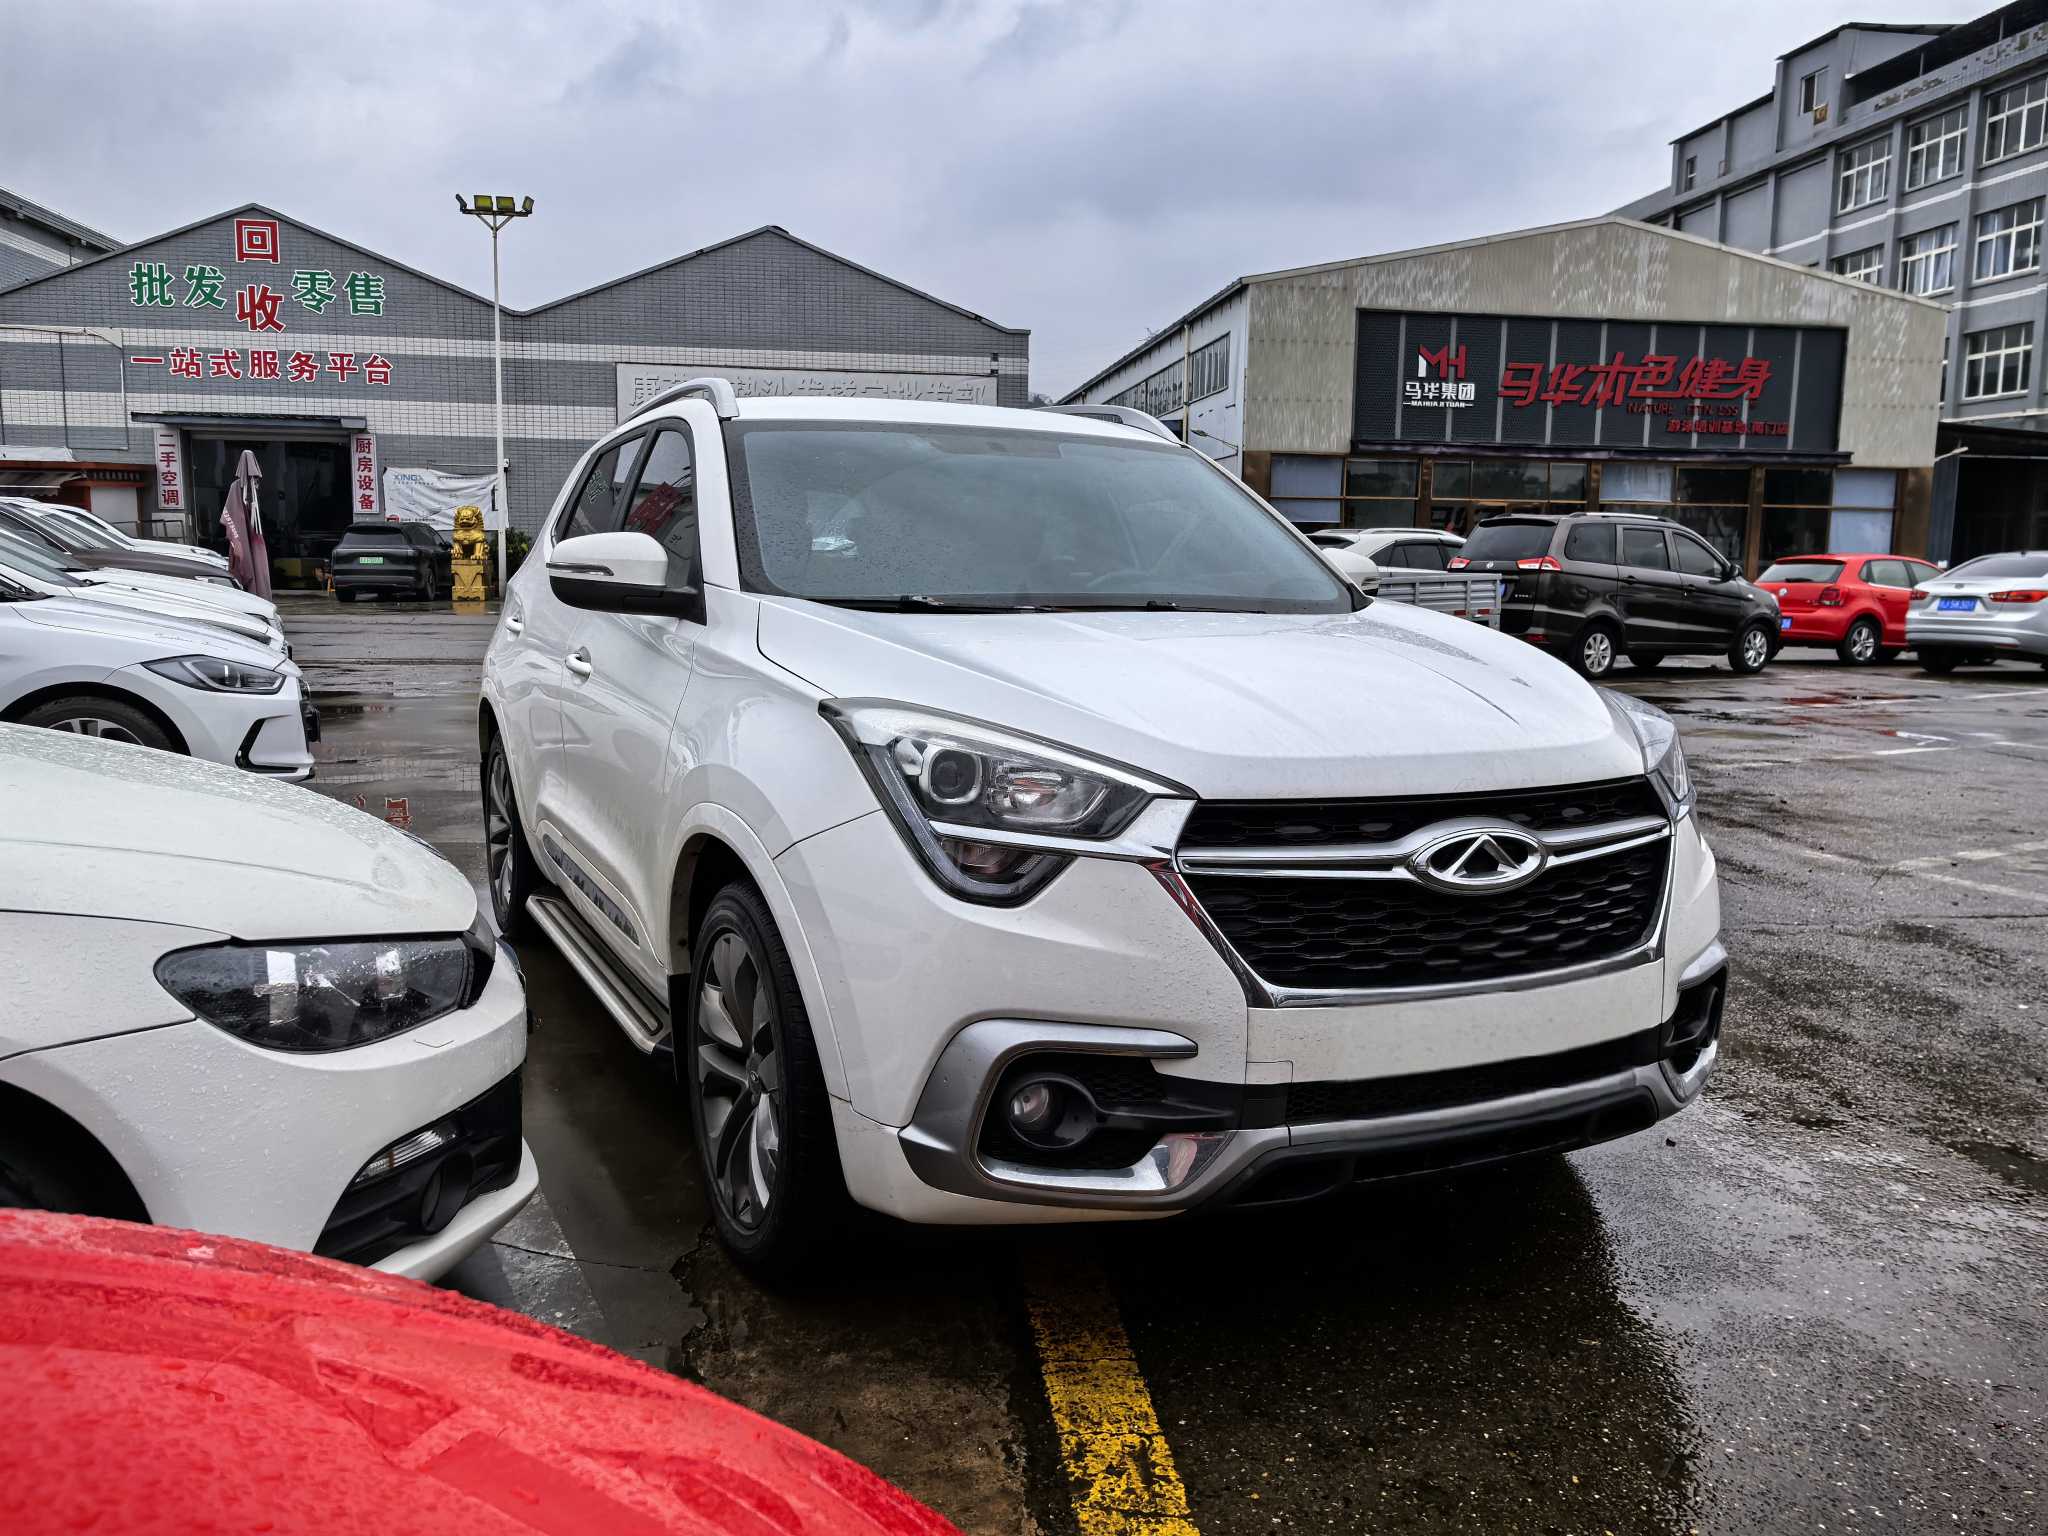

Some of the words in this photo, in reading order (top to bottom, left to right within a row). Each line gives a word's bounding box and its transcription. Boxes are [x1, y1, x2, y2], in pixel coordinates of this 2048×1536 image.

[128, 261, 228, 310] 批发
[290, 269, 386, 317] 零售
[234, 218, 287, 333] 回收
[130, 346, 394, 386] 一站式服务平台
[1404, 381, 1476, 401] 马华集团
[1498, 351, 1772, 409] 马华本色健身
[1627, 402, 1674, 415] NATURE
[158, 434, 180, 506] 二手空调
[355, 437, 375, 511] 厨房设备
